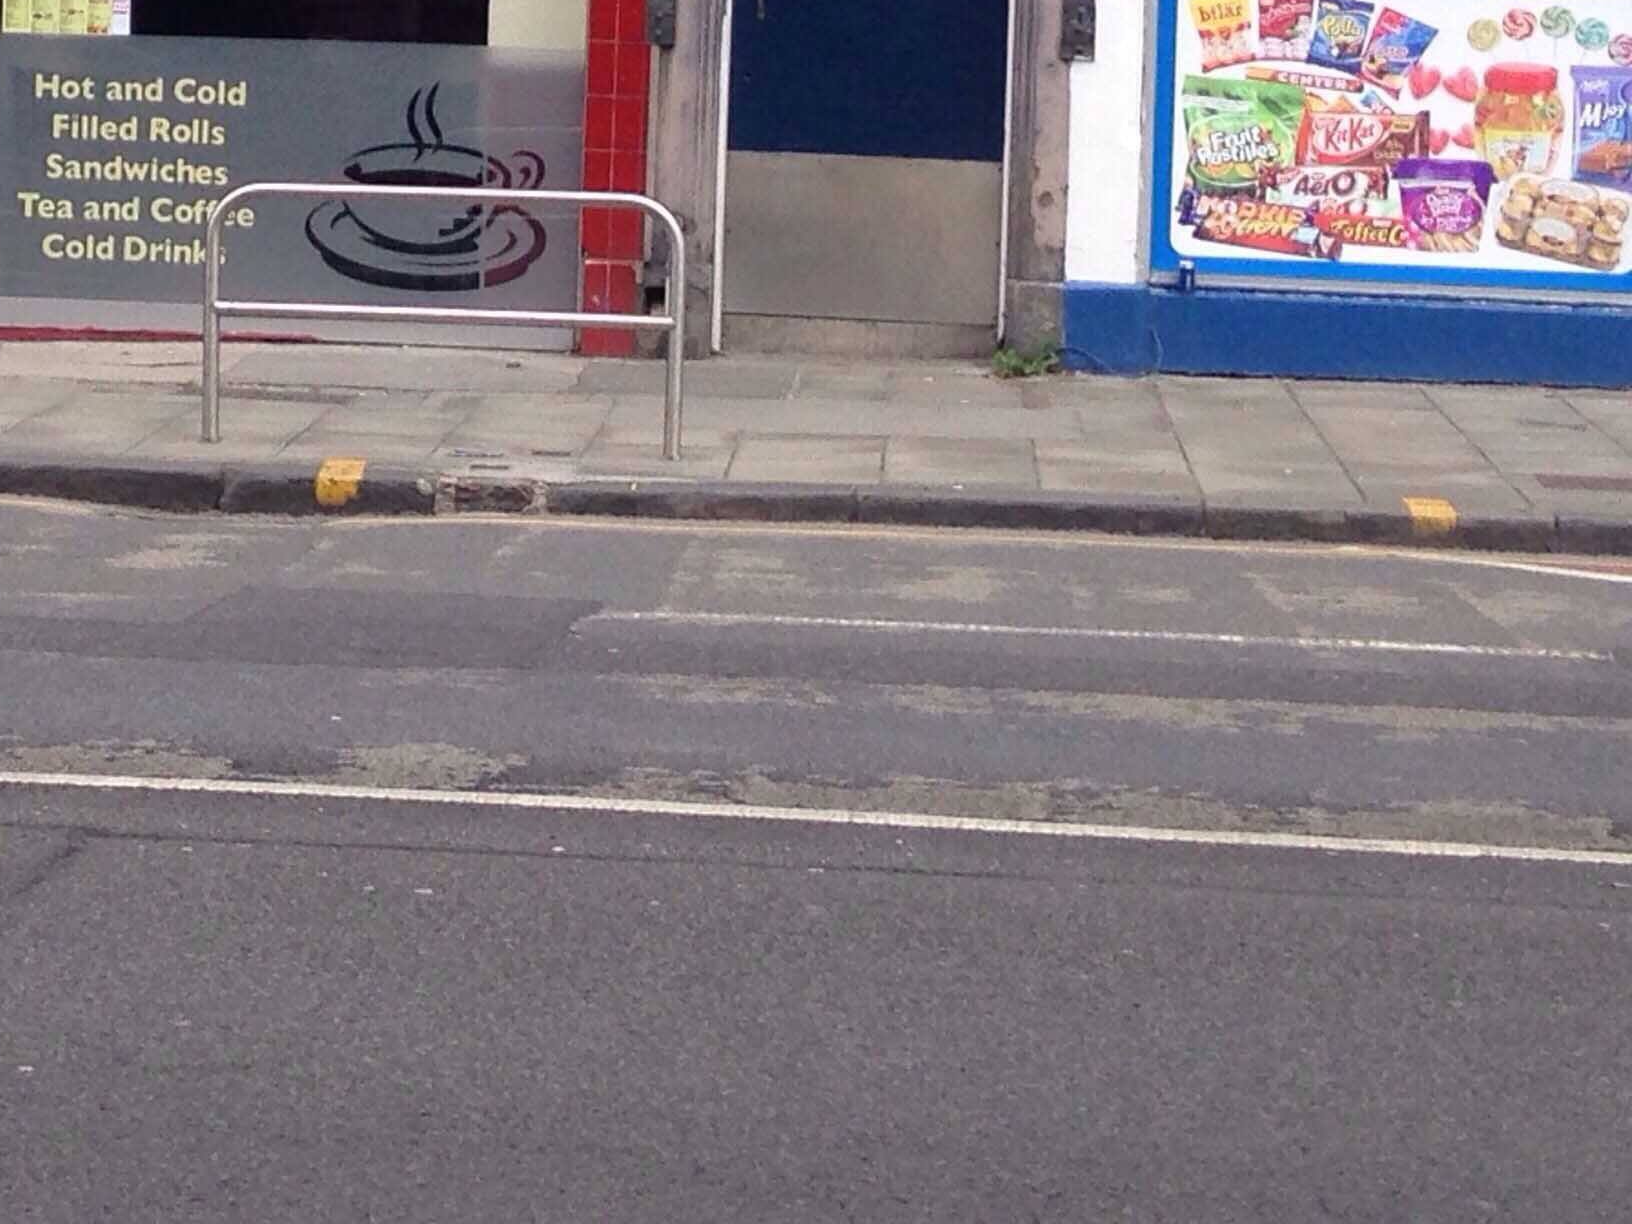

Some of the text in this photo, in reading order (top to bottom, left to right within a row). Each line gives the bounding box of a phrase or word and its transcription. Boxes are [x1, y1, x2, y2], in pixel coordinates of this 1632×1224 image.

[34, 73, 248, 107] Hot and Cold
[51, 113, 226, 145] Filled Rolls
[45, 153, 229, 186] Sandwiches
[17, 192, 73, 219] Tea
[83, 197, 140, 222] and
[41, 233, 115, 260] Cold
